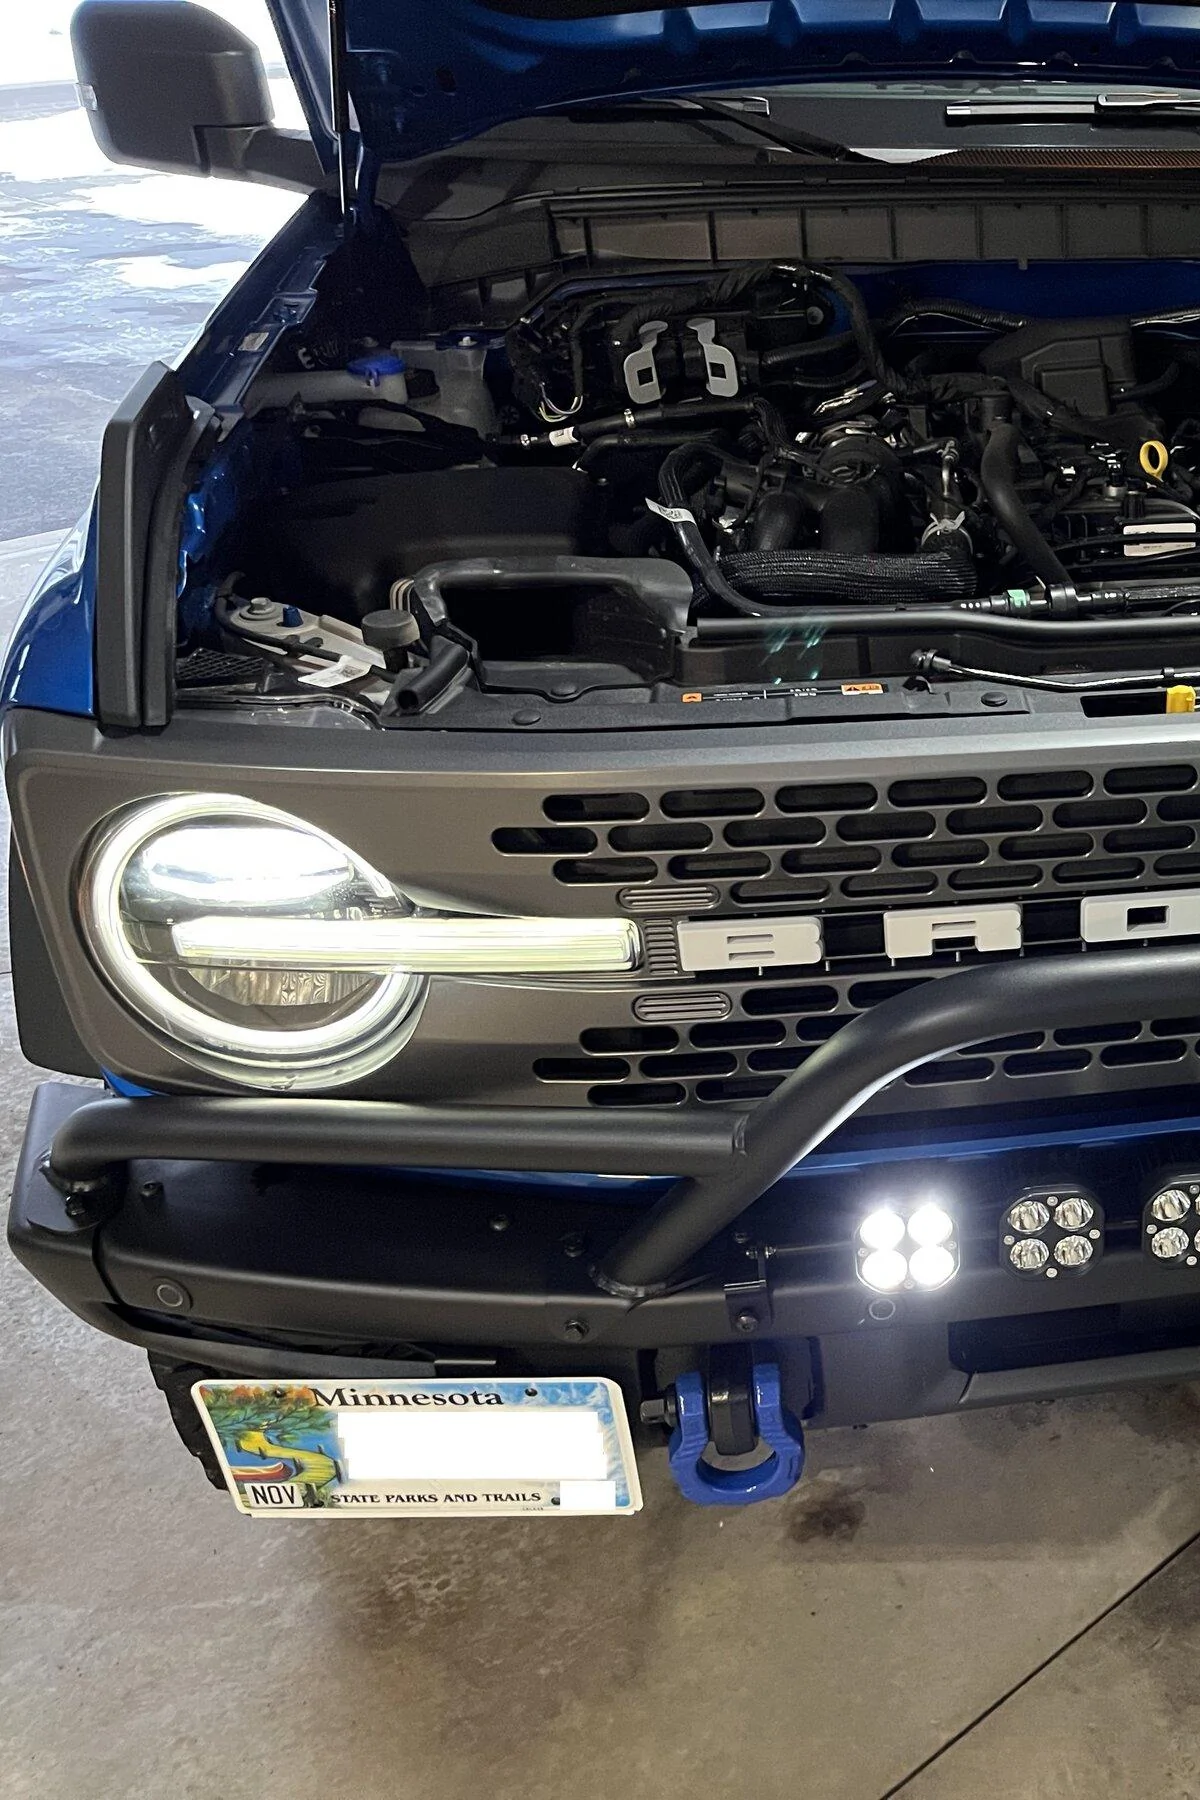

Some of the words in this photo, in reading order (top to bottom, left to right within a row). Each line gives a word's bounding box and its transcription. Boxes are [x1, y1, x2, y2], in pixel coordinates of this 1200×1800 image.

[307, 1386, 505, 1407] Minnesota
[251, 1485, 295, 1505] NOV
[331, 1494, 379, 1504] STATE
[385, 1493, 439, 1504] PARKS
[443, 1493, 478, 1503] AND
[482, 1492, 542, 1502] TRAILS
